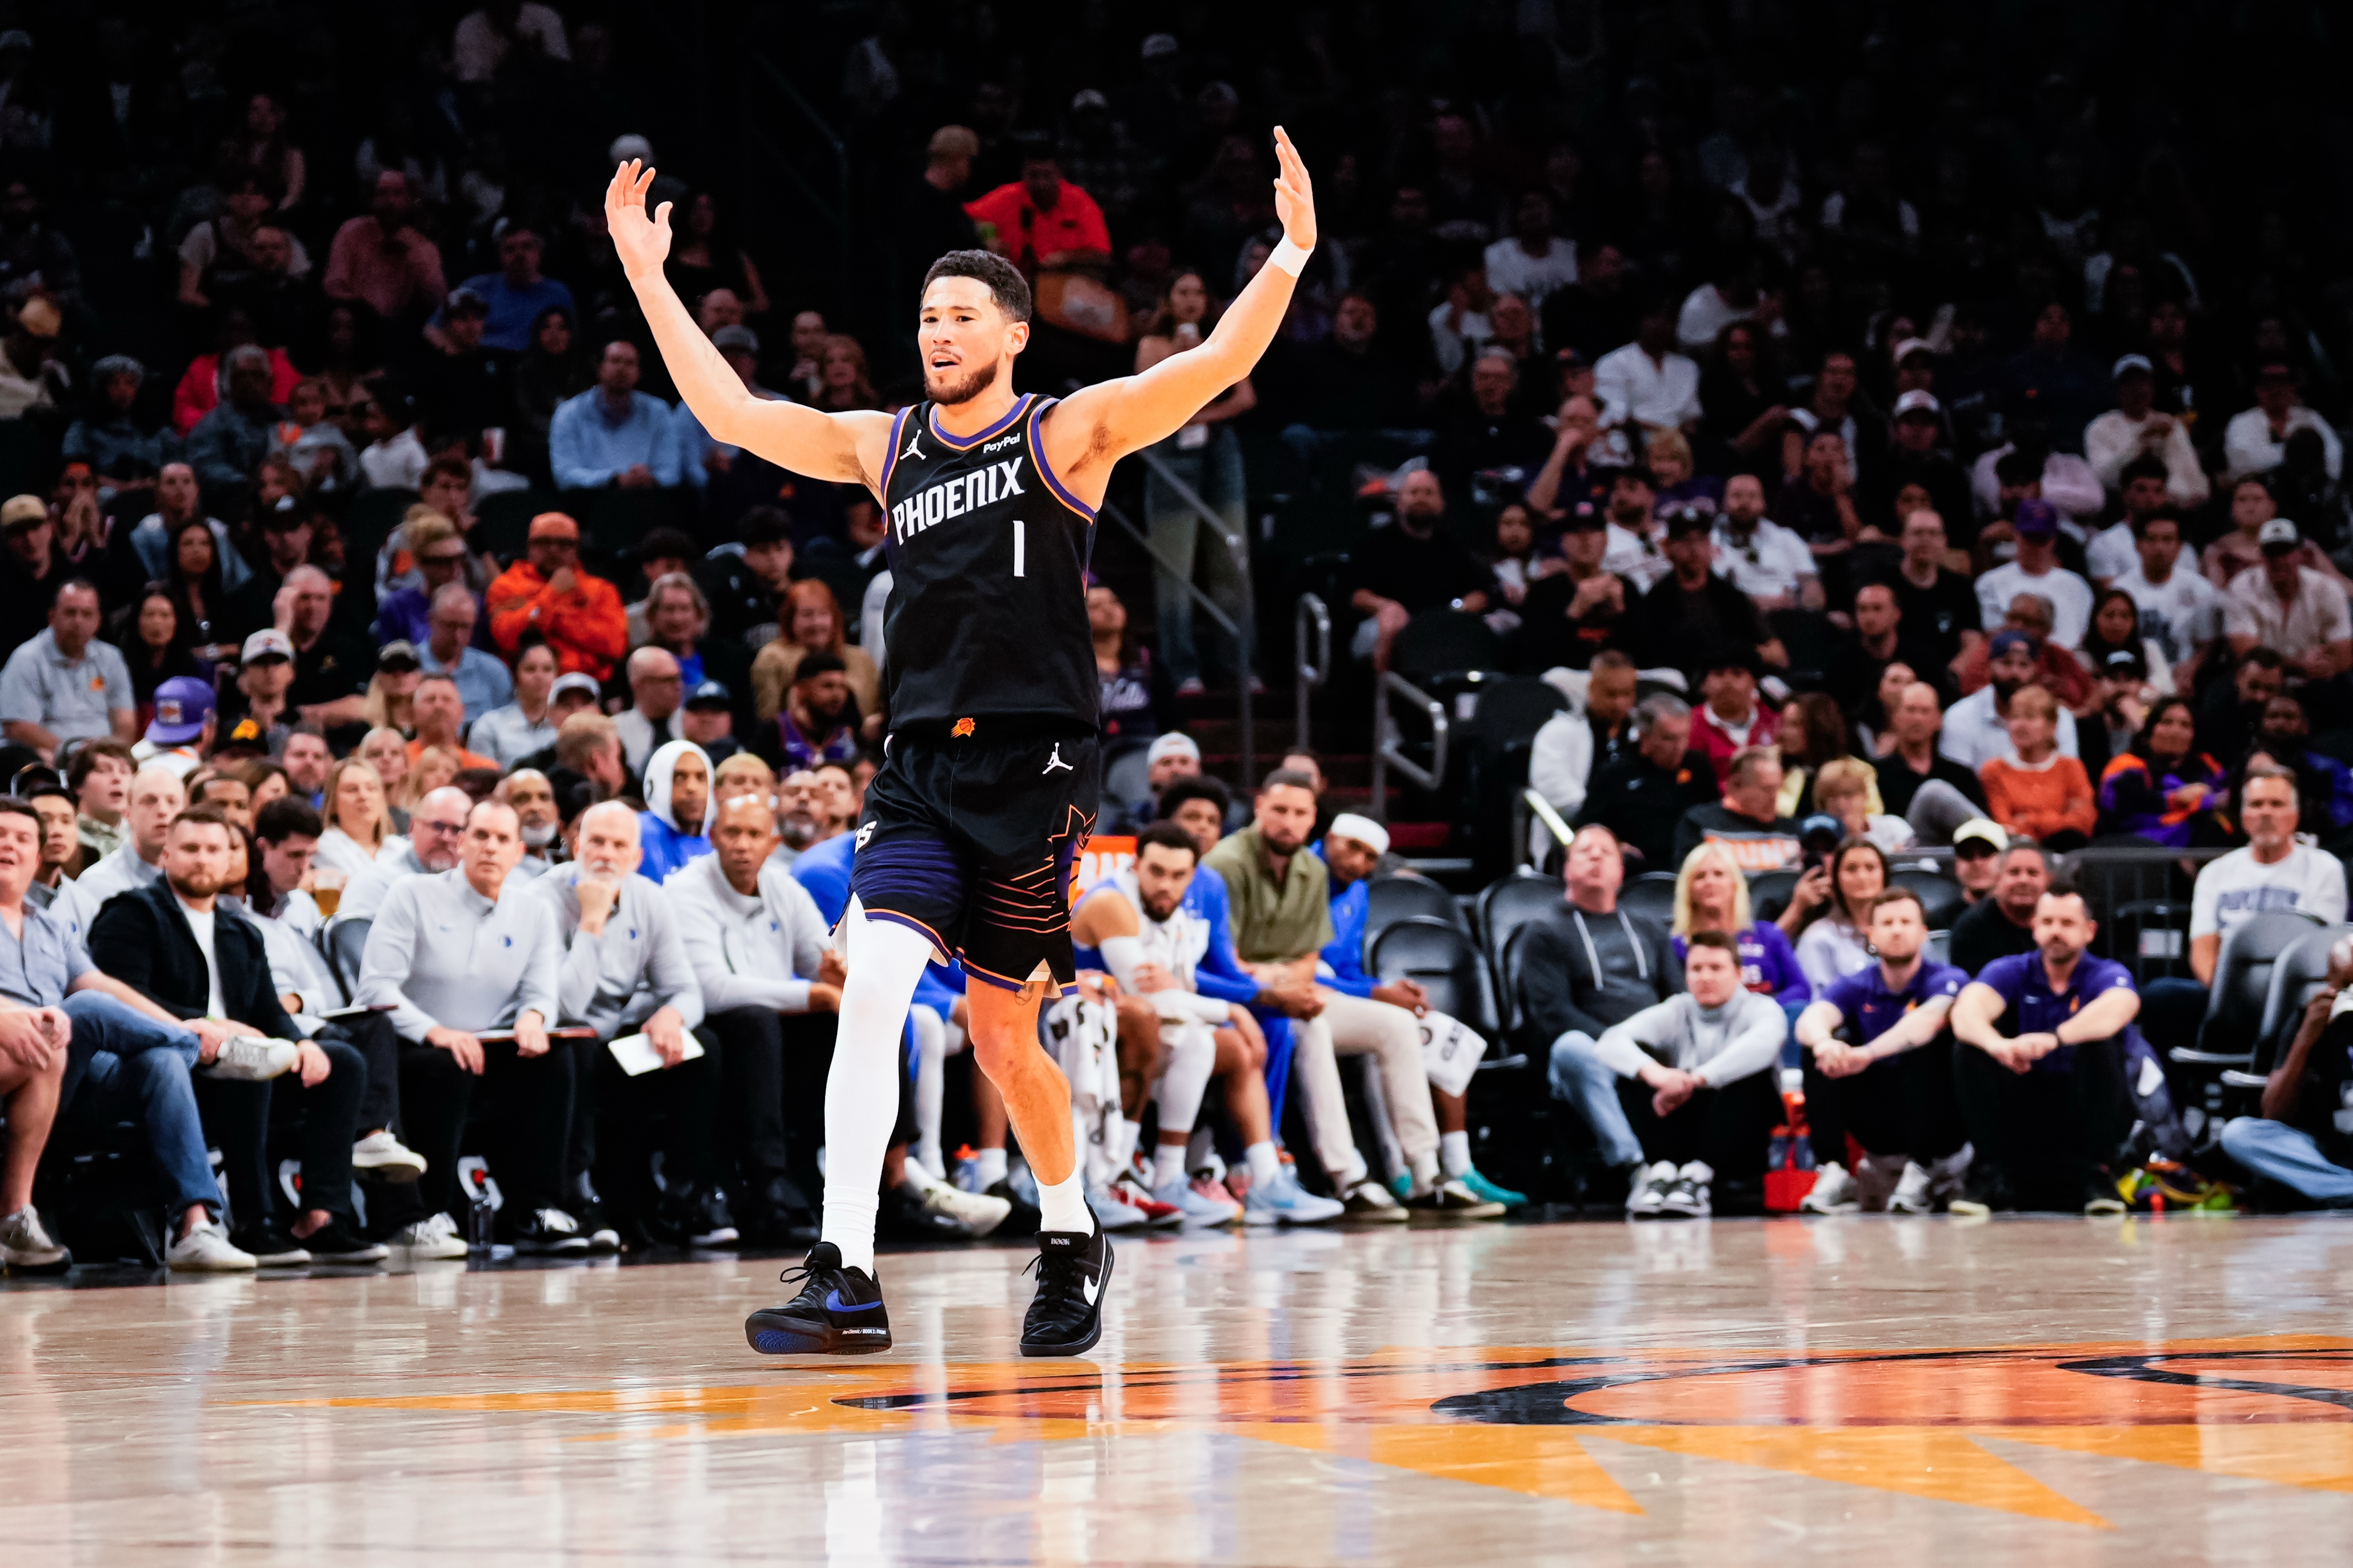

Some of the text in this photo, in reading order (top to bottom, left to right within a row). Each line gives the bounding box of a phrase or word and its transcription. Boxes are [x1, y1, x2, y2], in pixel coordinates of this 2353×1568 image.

[983, 433, 1021, 454] PayPal
[892, 456, 1025, 545] PHOENIX
[1013, 520, 1024, 577] 1
